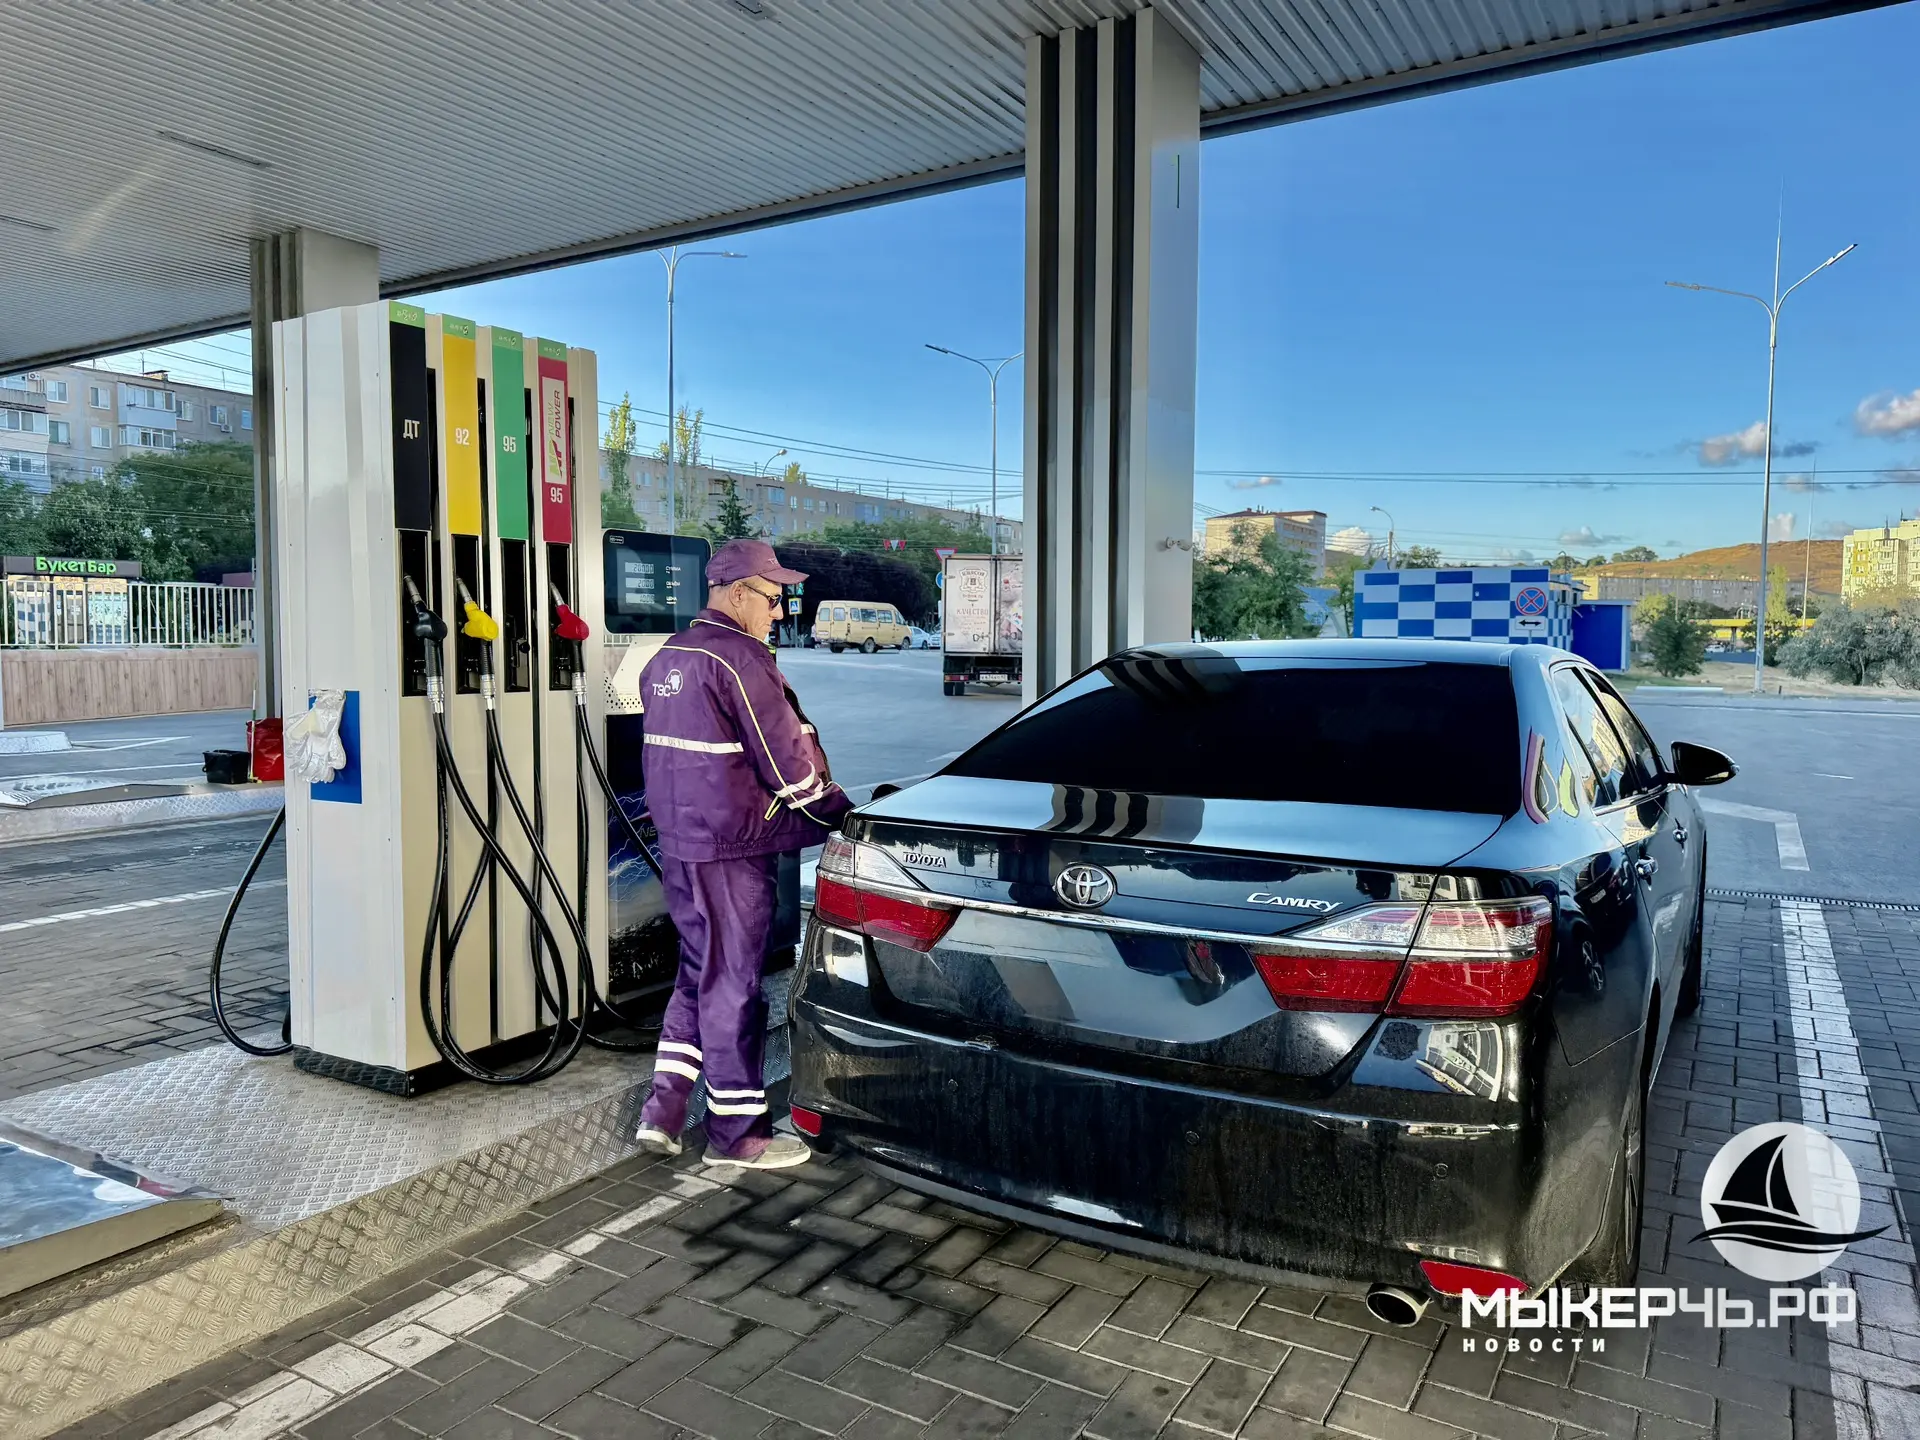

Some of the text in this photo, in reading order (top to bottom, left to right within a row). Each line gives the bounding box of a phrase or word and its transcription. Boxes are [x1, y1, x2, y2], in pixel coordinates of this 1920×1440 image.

[554, 390, 562, 438] POWER
[402, 418, 420, 440] ДТ
[455, 427, 470, 446] 92
[502, 435, 517, 453] 95
[550, 486, 563, 504] 95
[35, 556, 117, 575] Букет Бар
[903, 852, 947, 868] TOYOTA
[1246, 892, 1344, 913] CAMRY
